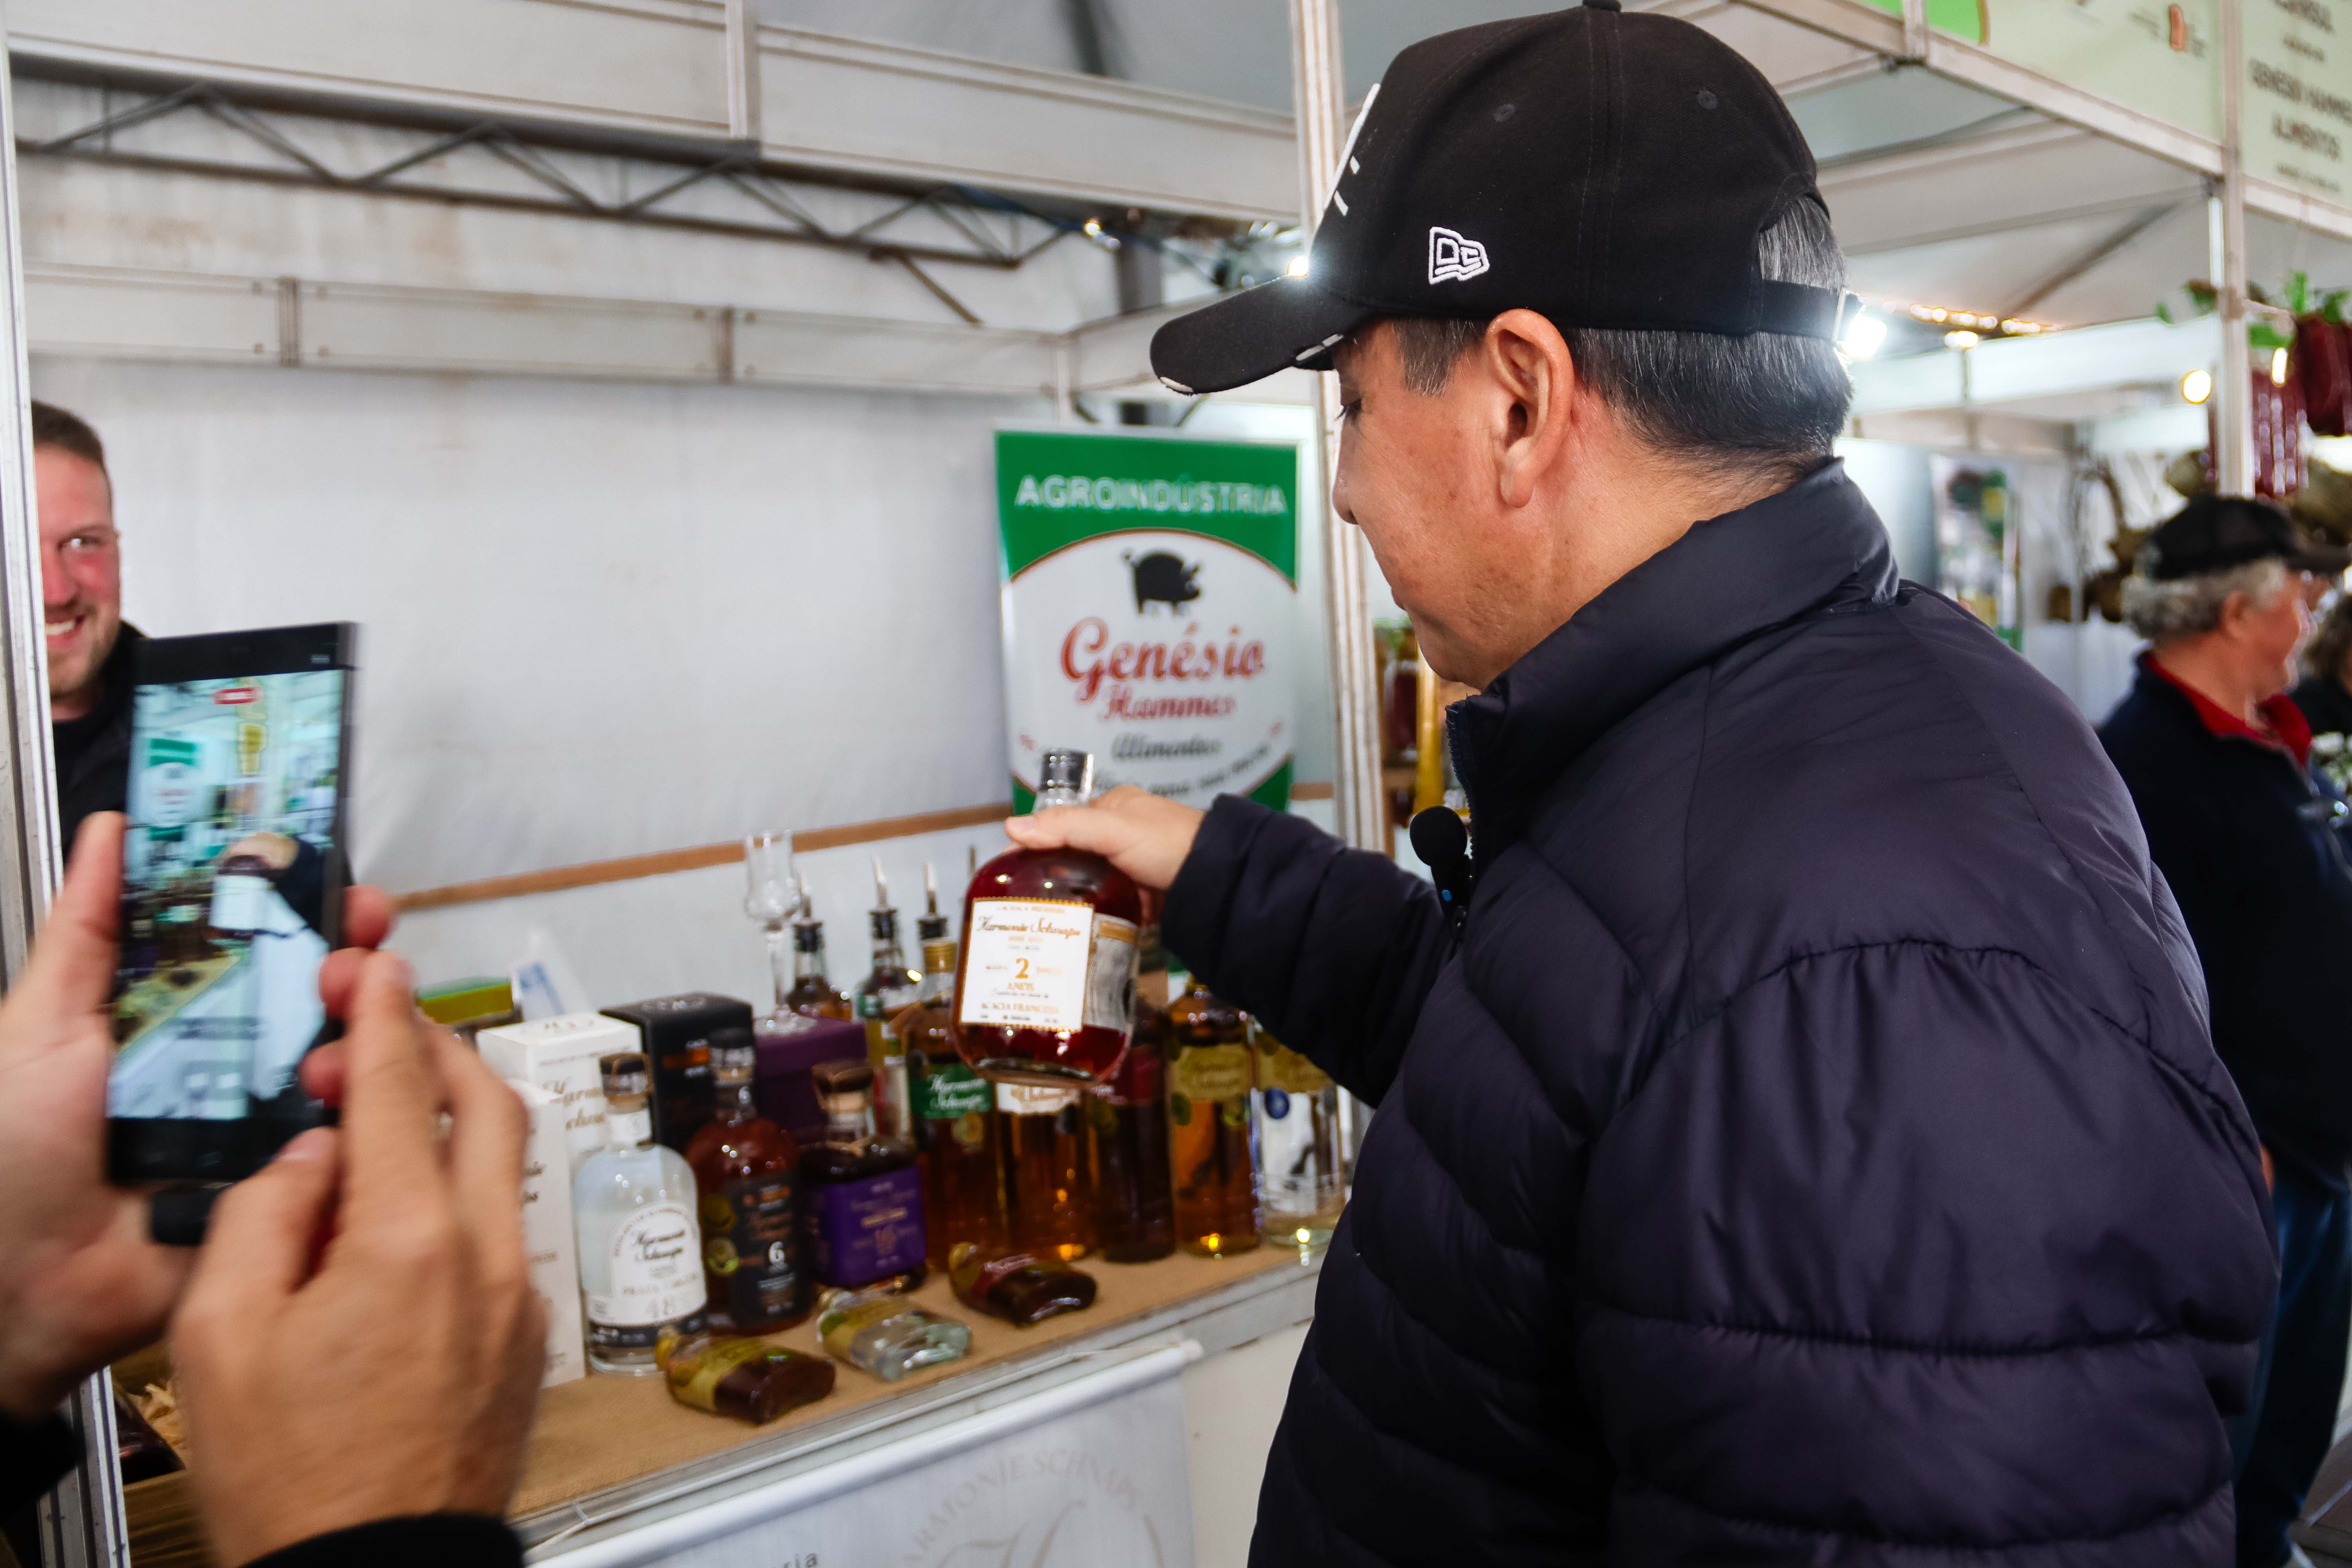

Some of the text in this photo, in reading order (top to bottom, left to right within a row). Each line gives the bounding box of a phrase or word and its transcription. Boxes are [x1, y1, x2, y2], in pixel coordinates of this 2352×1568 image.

[1060, 617, 1265, 704] Genésio
[1015, 957, 1029, 979] 2
[768, 1241, 785, 1264] 6
